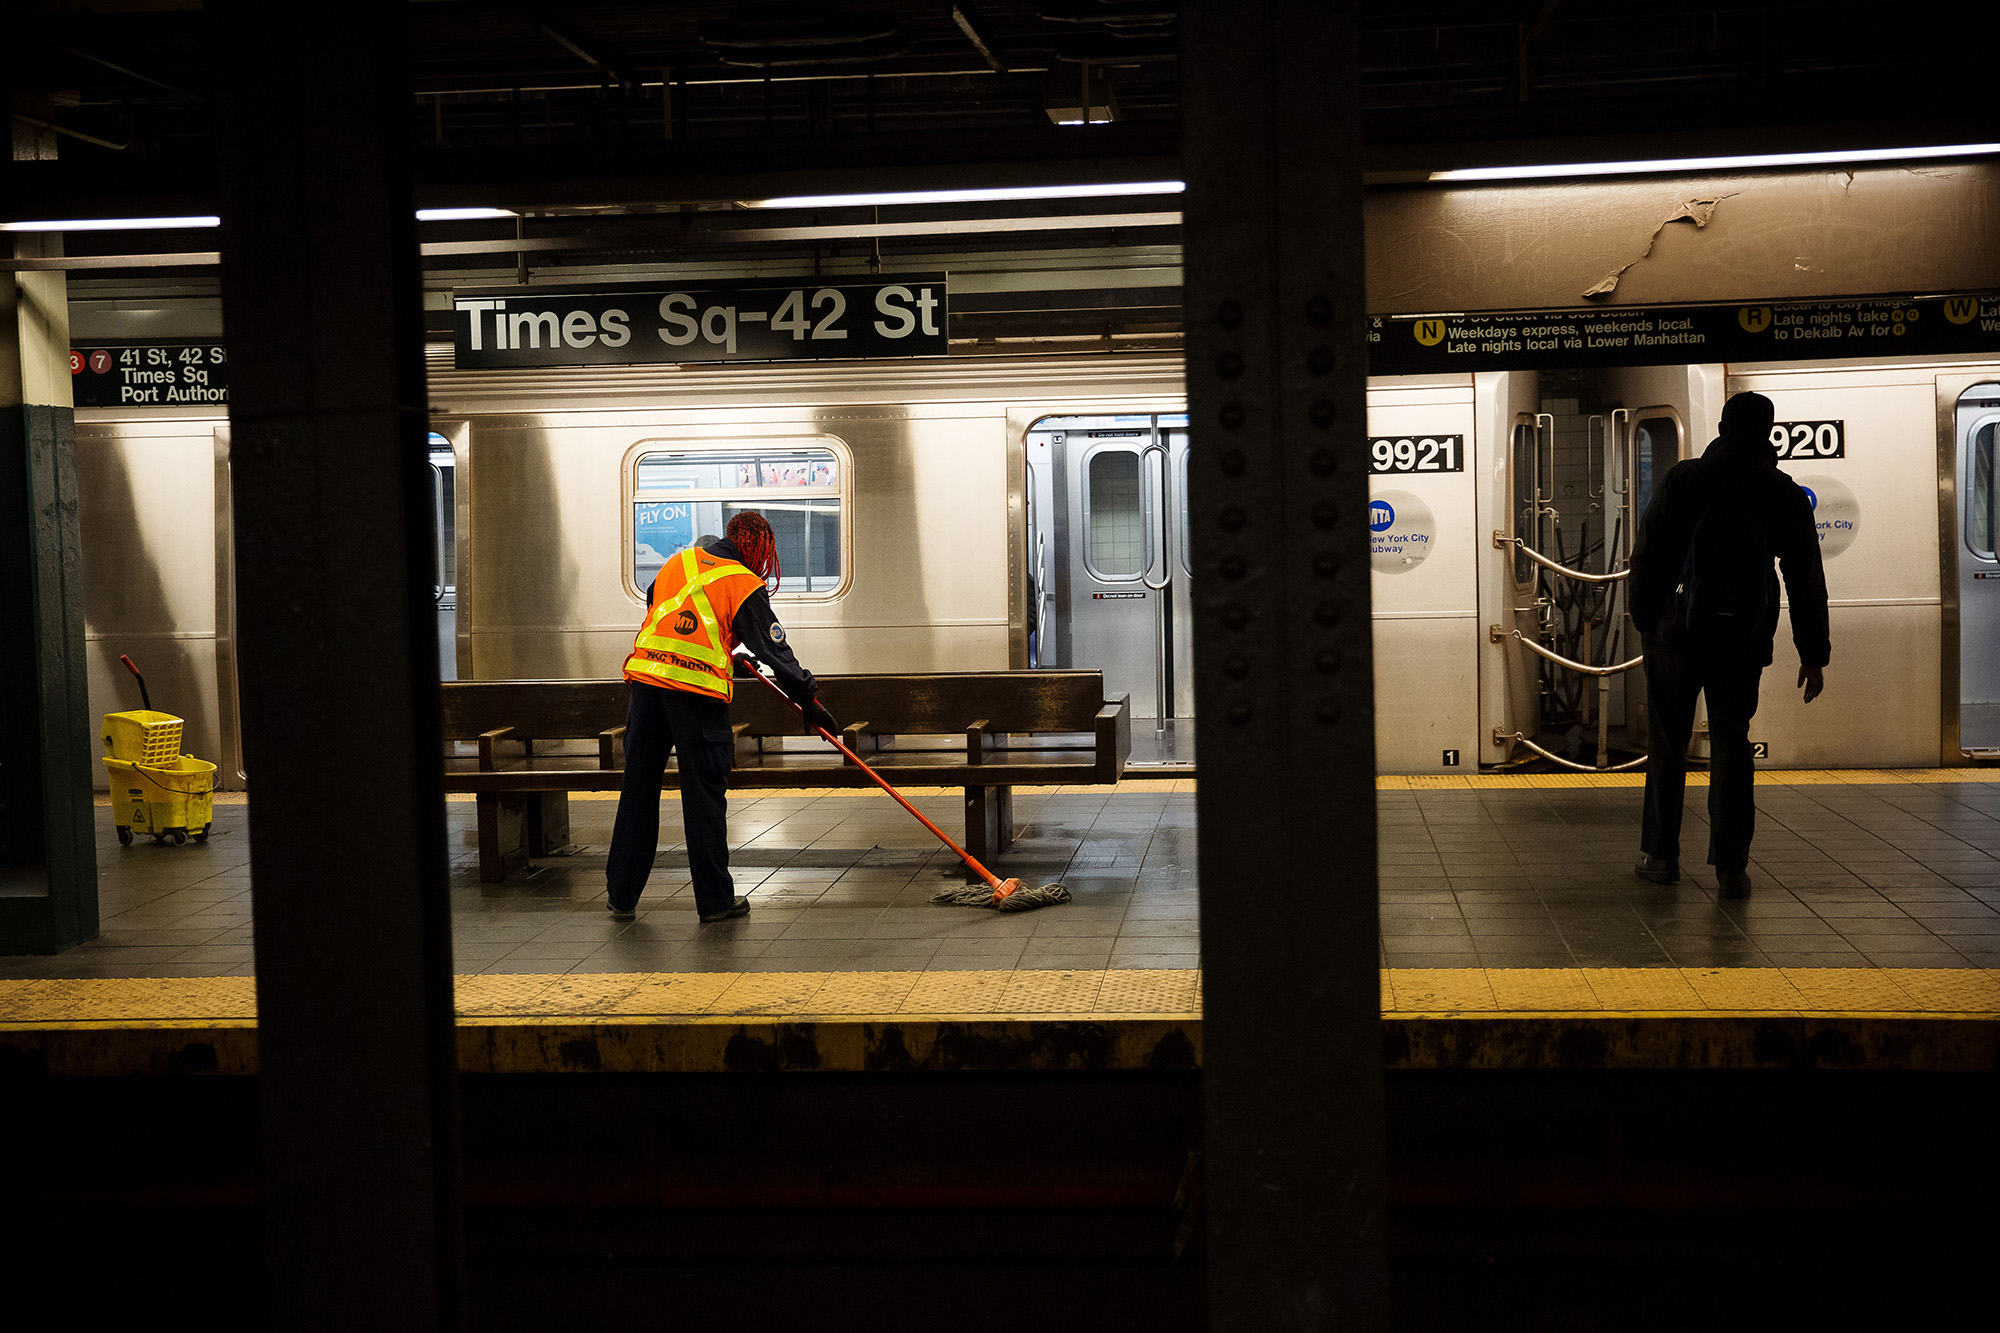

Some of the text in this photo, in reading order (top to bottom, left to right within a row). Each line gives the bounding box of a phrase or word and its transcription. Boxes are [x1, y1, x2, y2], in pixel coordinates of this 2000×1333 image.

[1950, 297, 1972, 317] W
[456, 285, 940, 354] Times Sq-42 St
[1747, 308, 1762, 325] R
[1774, 313, 1805, 326] Late
[1810, 311, 1851, 327] nights
[1857, 310, 1889, 323] take
[1422, 321, 1437, 339] N
[1448, 326, 1517, 340] Weekdays
[1522, 324, 1580, 339] express,
[1584, 320, 1653, 334] weekends
[1658, 317, 1694, 331] local.
[1774, 328, 1789, 341] to
[1794, 326, 1843, 339] Dekalb
[1848, 325, 1865, 337] Av
[1870, 324, 1890, 336] for
[1447, 332, 1706, 354] Late nights local via Lower Manhattan
[70, 355, 106, 370] 3 7
[120, 349, 141, 366] 41
[147, 348, 173, 367] St,
[178, 348, 203, 365] 42
[120, 366, 209, 386] Times Sq
[121, 386, 159, 402] Port
[1769, 424, 1839, 457] 920
[1372, 438, 1454, 471] 9921
[640, 509, 660, 526] FLY
[663, 504, 690, 521] ON.
[1369, 507, 1391, 525] MTA
[1834, 520, 1854, 530] City
[1387, 534, 1409, 543] York
[1411, 533, 1430, 543] City
[1370, 545, 1404, 554] ubway
[676, 615, 694, 630] MTA
[1446, 750, 1454, 765] 1
[1753, 743, 1765, 758] 2
